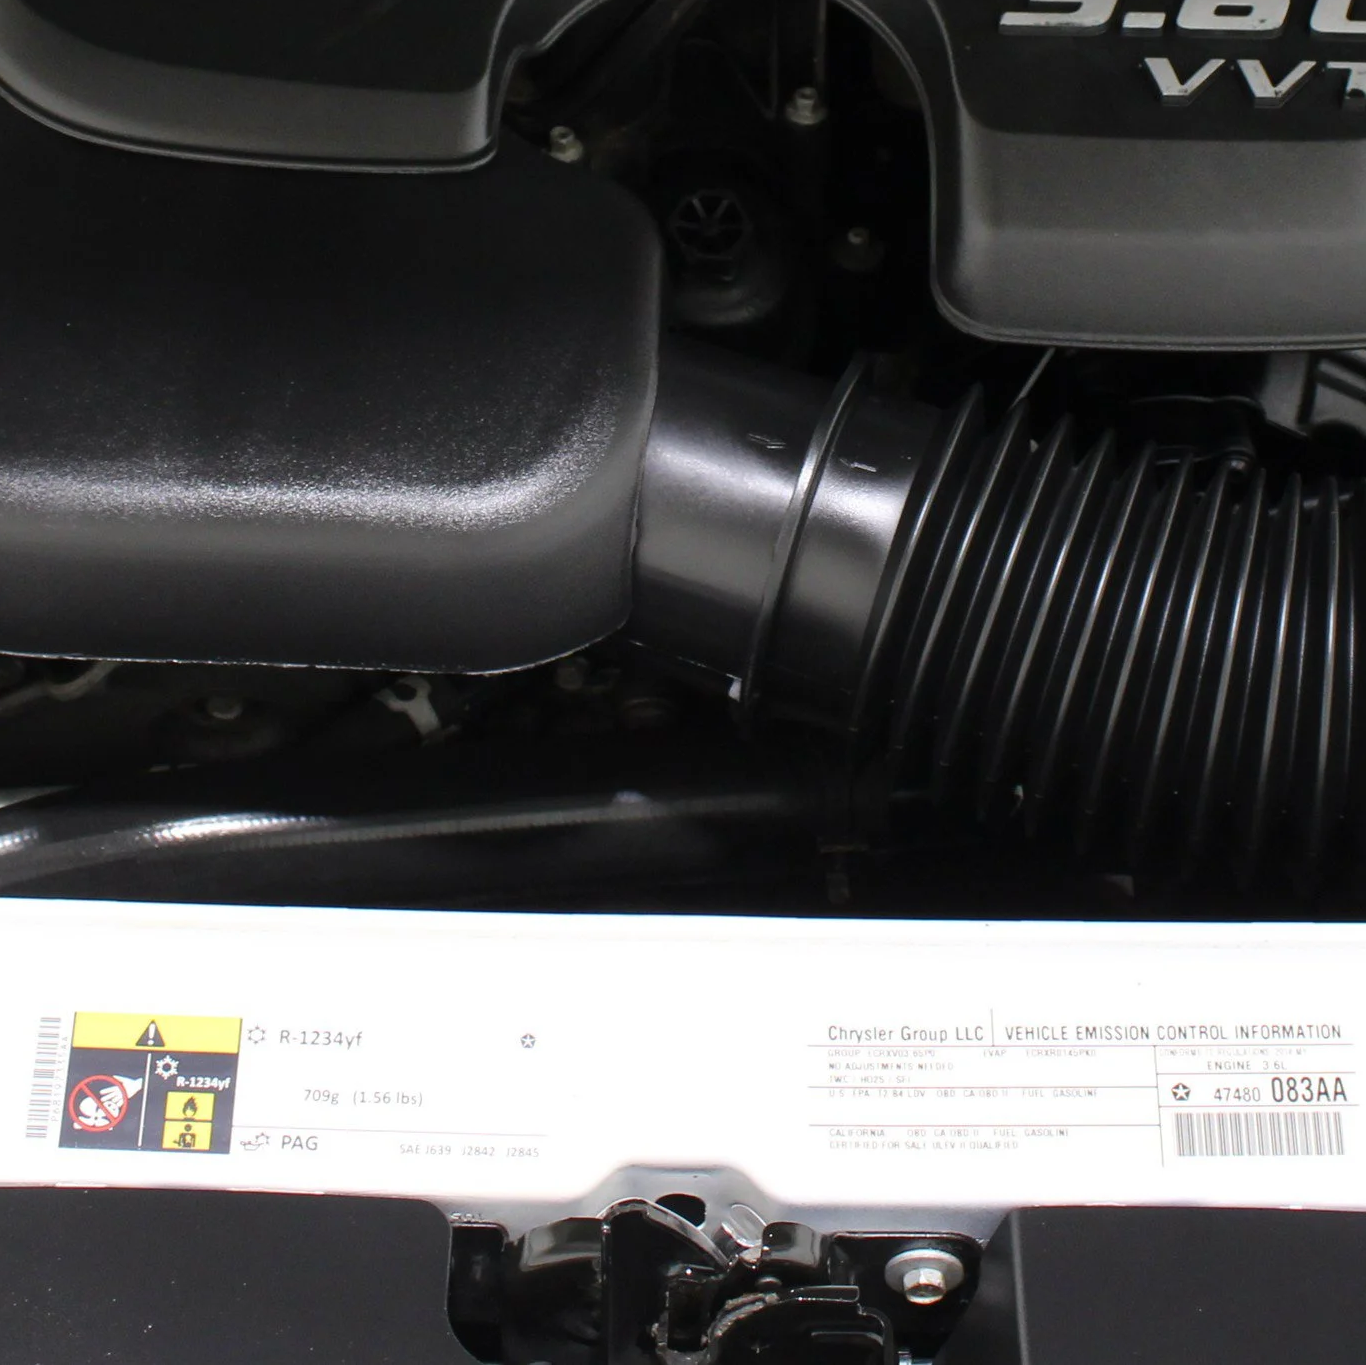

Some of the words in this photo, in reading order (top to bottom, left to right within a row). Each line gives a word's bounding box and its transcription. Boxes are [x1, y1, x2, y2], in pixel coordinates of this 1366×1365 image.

[280, 1029, 363, 1048] R-1234yf
[828, 1026, 893, 1044] Chrysler
[901, 1026, 949, 1043] Group
[956, 1026, 984, 1041] LLC
[1005, 1025, 1068, 1041] VEHICLE
[1076, 1025, 1150, 1041] EMISSION
[1157, 1025, 1227, 1041] CONTROL
[1236, 1025, 1341, 1040] INFORMATION
[1207, 1061, 1251, 1070] ENGINE
[1263, 1061, 1287, 1070] 36L
[176, 1075, 230, 1090] R-1234yf
[1214, 1087, 1261, 1102] 47480
[1271, 1076, 1348, 1103] 083AA
[303, 1089, 339, 1105] 709g
[353, 1090, 391, 1106] (1.56
[396, 1091, 424, 1108] lbs)
[829, 1129, 885, 1137] CALIFORNIA
[281, 1135, 318, 1152] PAG
[400, 1144, 421, 1154] SAE
